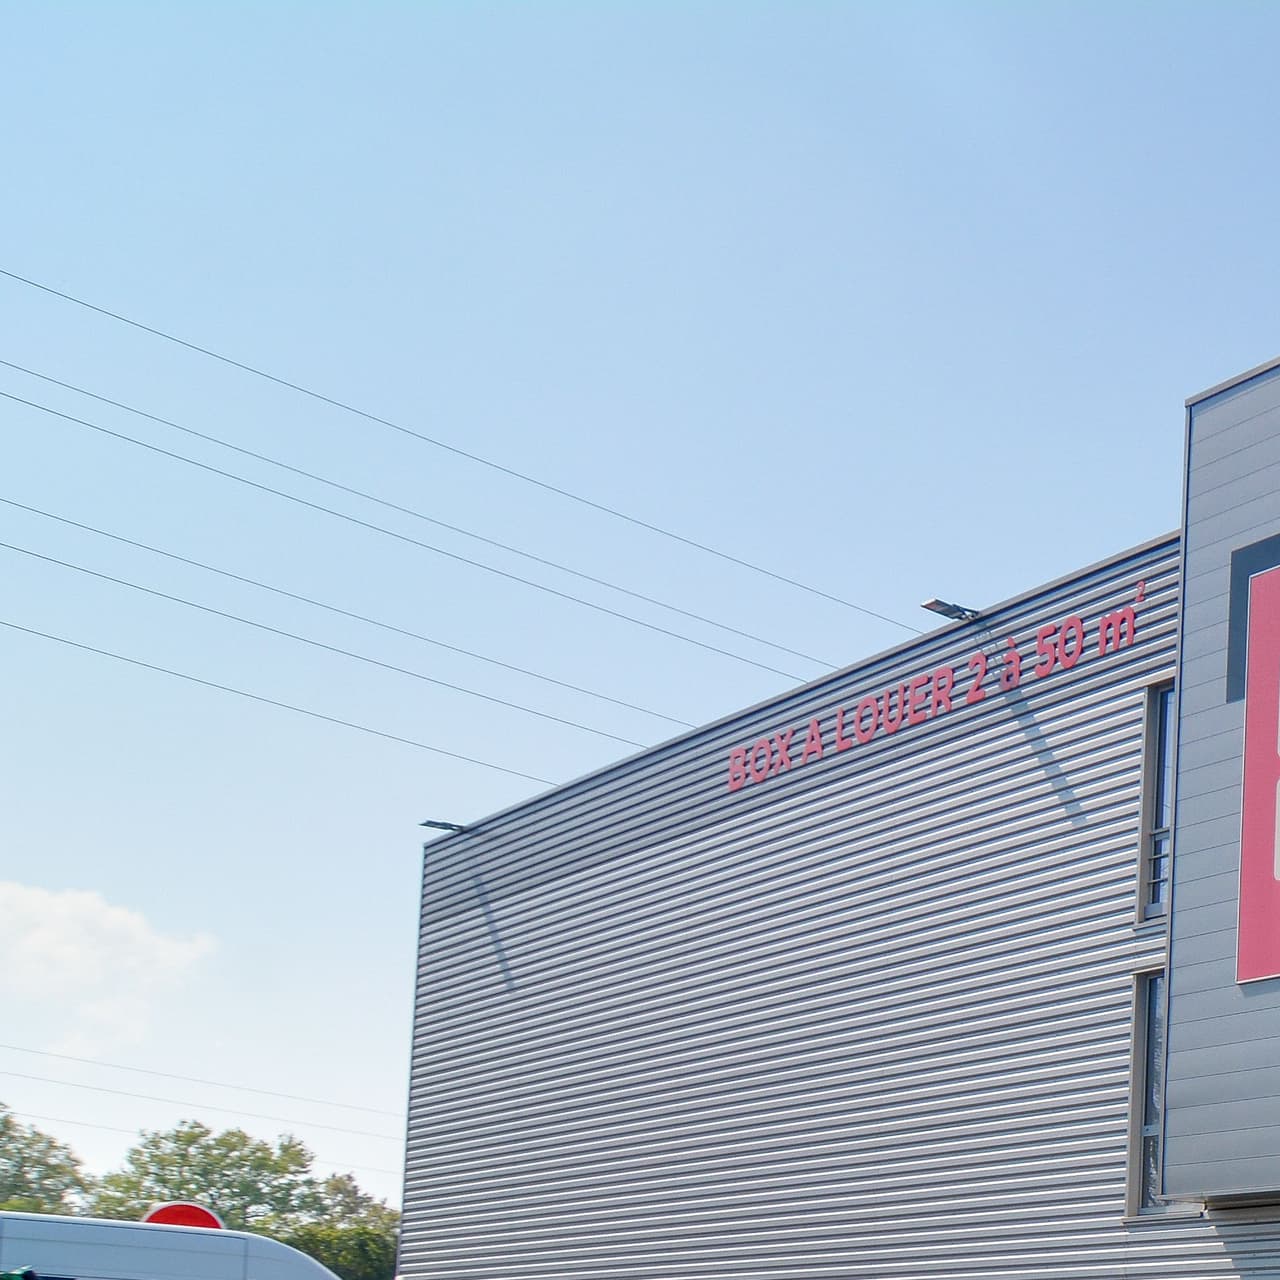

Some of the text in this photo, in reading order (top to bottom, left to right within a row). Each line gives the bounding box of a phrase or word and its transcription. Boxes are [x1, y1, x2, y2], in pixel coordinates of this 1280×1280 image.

[728, 727, 795, 792] BOX
[801, 718, 824, 764] A
[835, 665, 954, 751] LOUER
[966, 651, 987, 704] 2
[1000, 636, 1022, 691] à
[1034, 615, 1084, 678] 50
